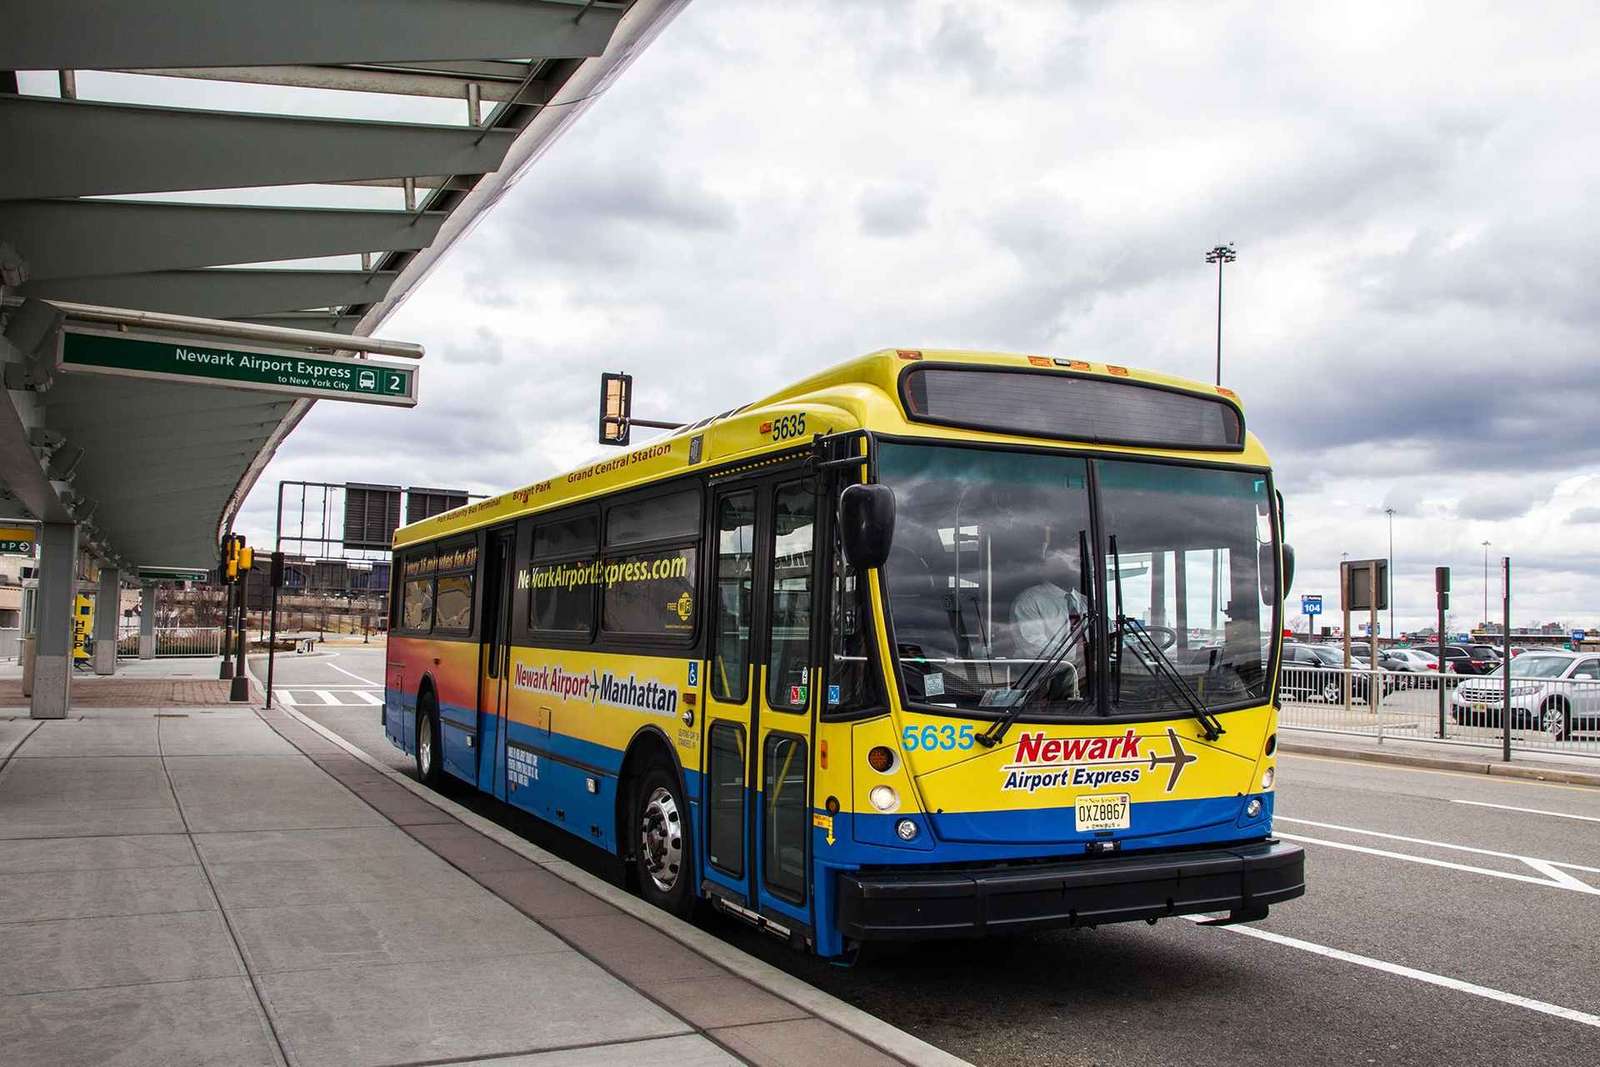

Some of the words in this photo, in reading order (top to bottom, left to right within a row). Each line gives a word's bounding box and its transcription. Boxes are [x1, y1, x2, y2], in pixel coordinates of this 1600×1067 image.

[176, 348, 235, 367] Newark
[240, 356, 292, 373] Airport
[298, 362, 351, 379] Express
[278, 375, 287, 384] to
[289, 376, 310, 386] New
[311, 378, 331, 388] York
[333, 380, 351, 391] City
[389, 375, 400, 391] 2
[773, 413, 806, 442] 5635
[567, 466, 593, 483] Grand
[595, 453, 630, 476] Central
[631, 444, 672, 464] Station
[535, 480, 552, 494] Park
[1304, 604, 1320, 612] 104
[74, 620, 85, 649] HELP
[515, 663, 549, 690] Newark
[550, 667, 590, 700] Airport
[600, 673, 678, 713] Manhattan
[902, 725, 975, 752] 5635
[1015, 730, 1142, 763] Newark
[1004, 769, 1068, 791] Airport
[1072, 768, 1139, 788] Express
